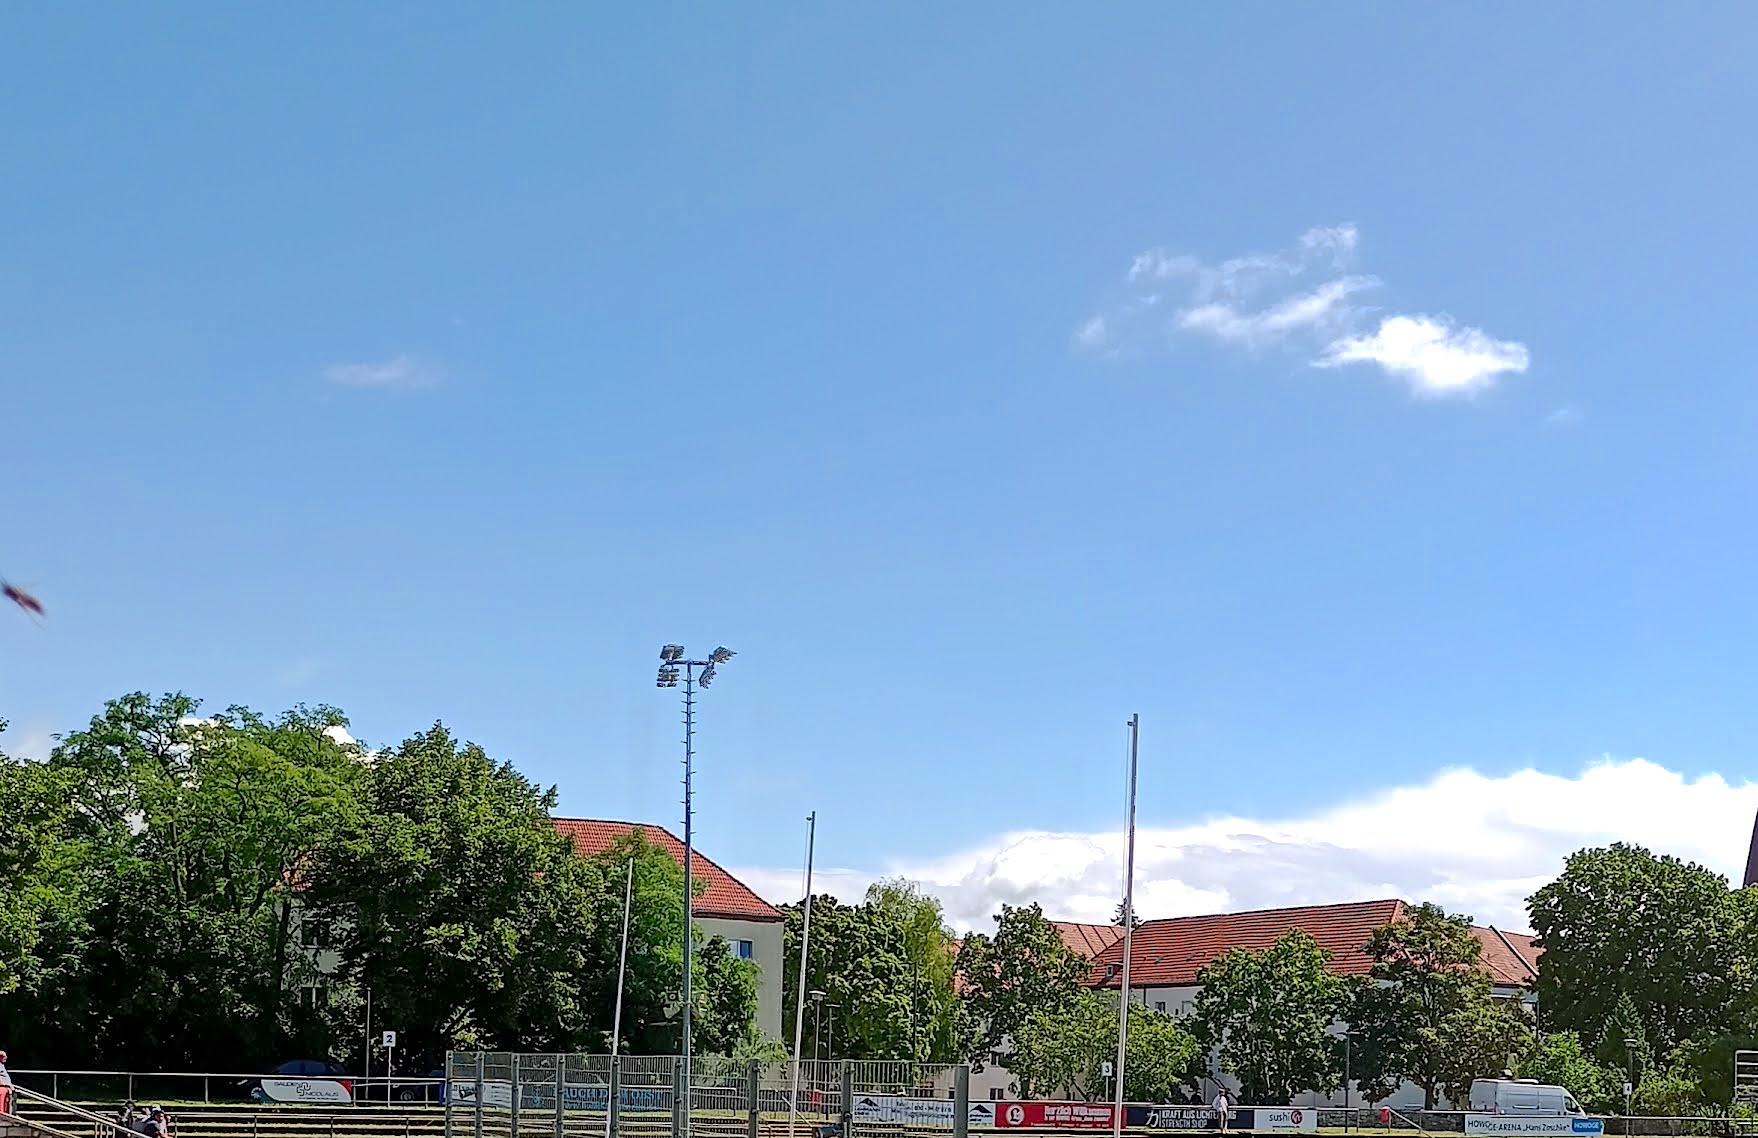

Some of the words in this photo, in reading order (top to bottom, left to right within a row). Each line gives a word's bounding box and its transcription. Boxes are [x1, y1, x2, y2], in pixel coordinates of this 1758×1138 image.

[1162, 1109, 1182, 1119] KRAFT
[1182, 1110, 1195, 1119] AUS
[1268, 1112, 1290, 1122] sushi
[1161, 1118, 1191, 1128] STRENGTH
[1191, 1118, 1208, 1128] SHOP
